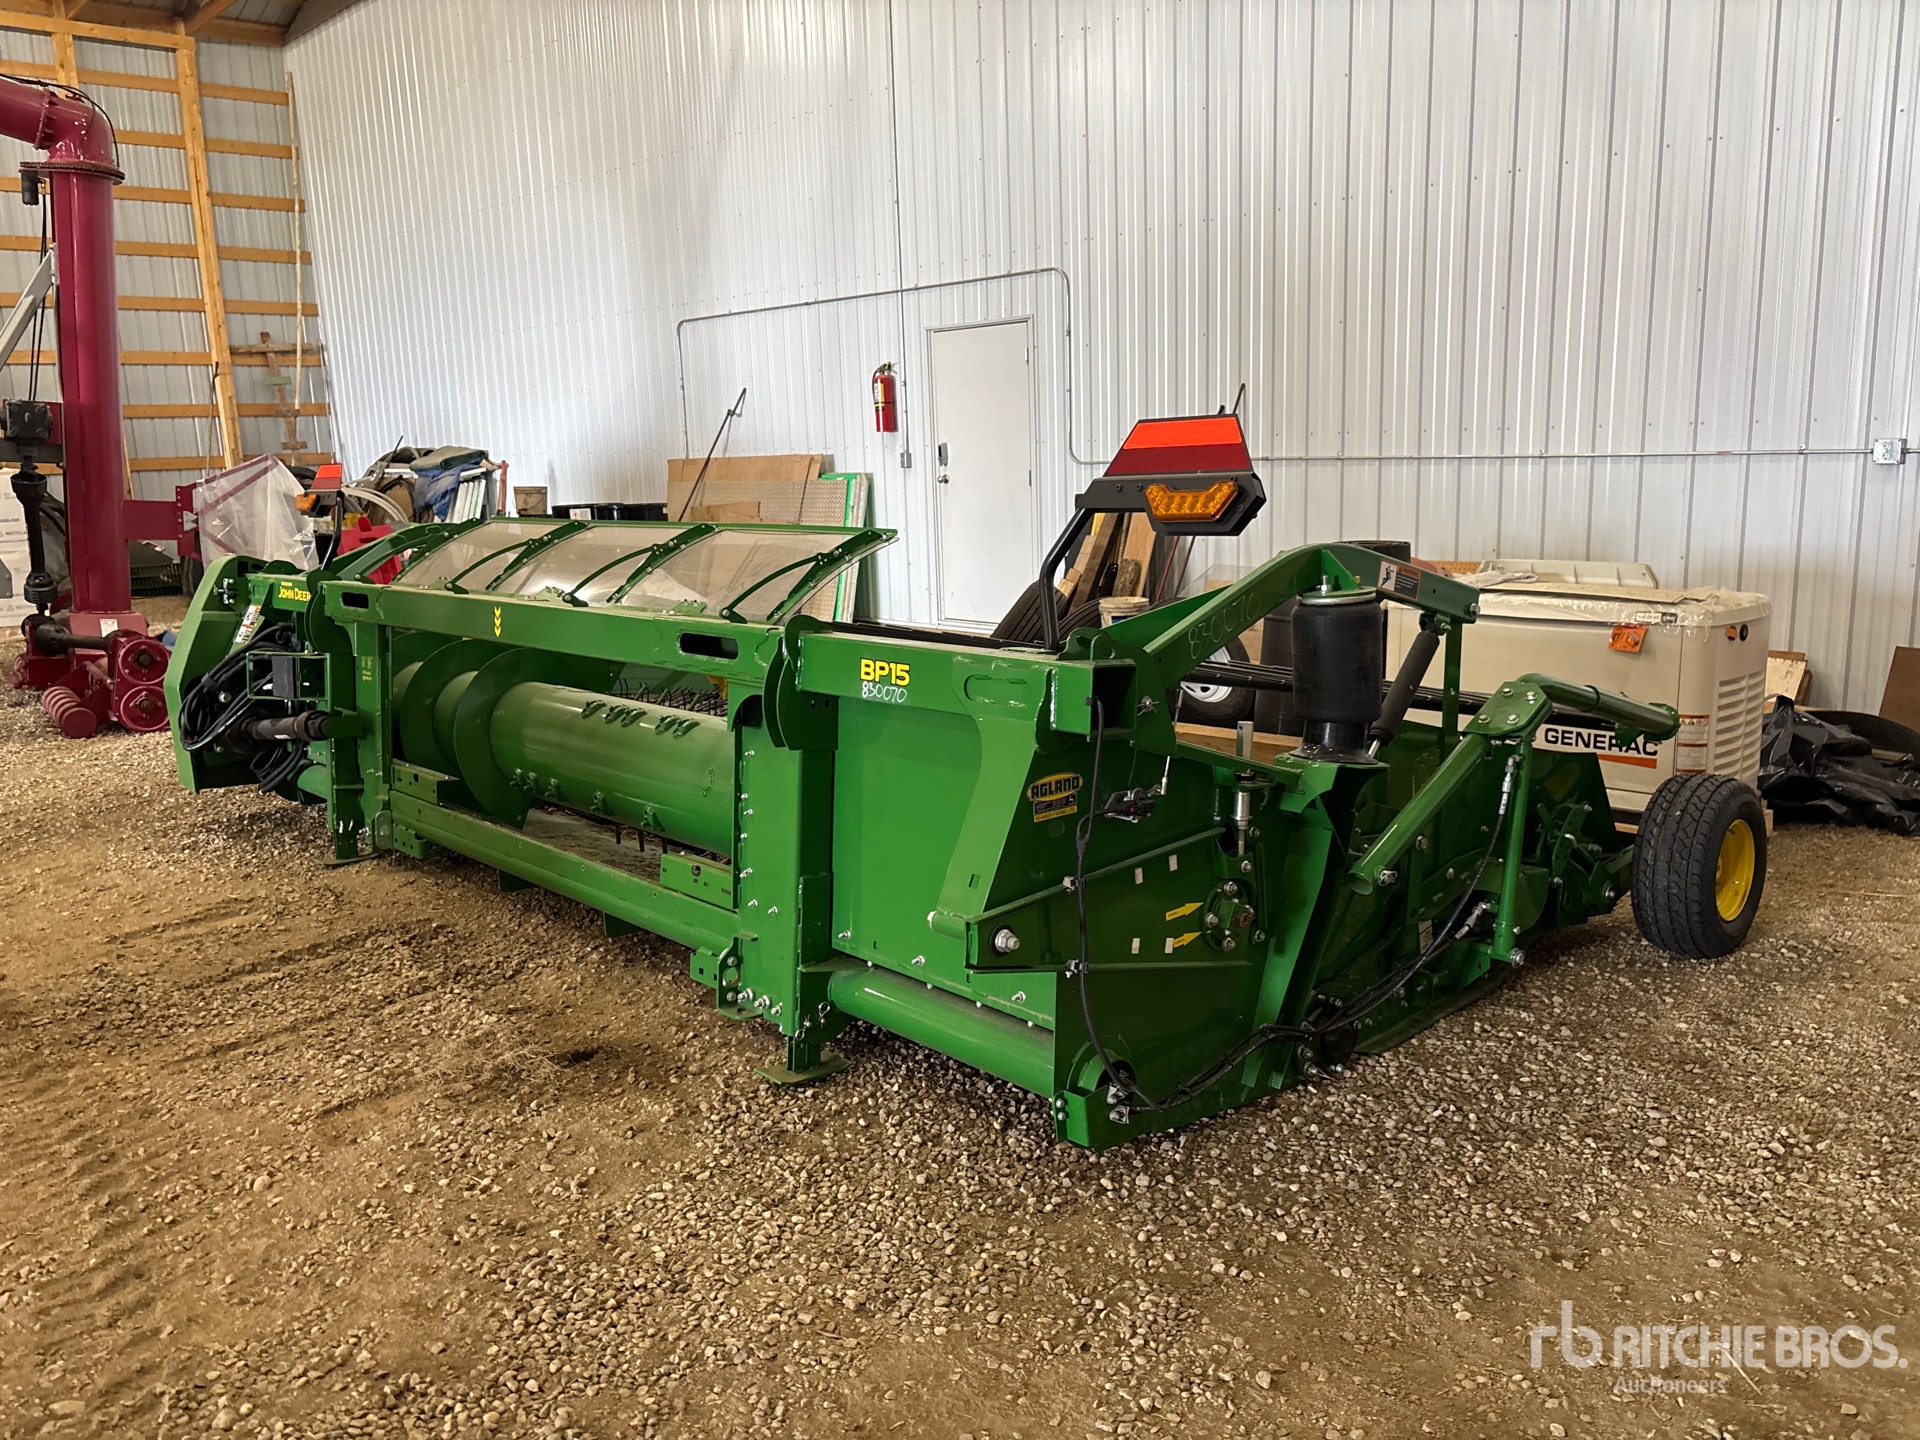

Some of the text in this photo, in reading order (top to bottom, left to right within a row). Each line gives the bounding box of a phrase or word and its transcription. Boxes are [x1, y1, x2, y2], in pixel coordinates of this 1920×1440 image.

[278, 586, 294, 600] JOHN
[1188, 593, 1260, 660] 830070
[860, 657, 911, 687] BP15
[862, 681, 908, 703] 830070
[1544, 728, 1658, 756] GENERAC
[1031, 776, 1080, 798] AGLAND
